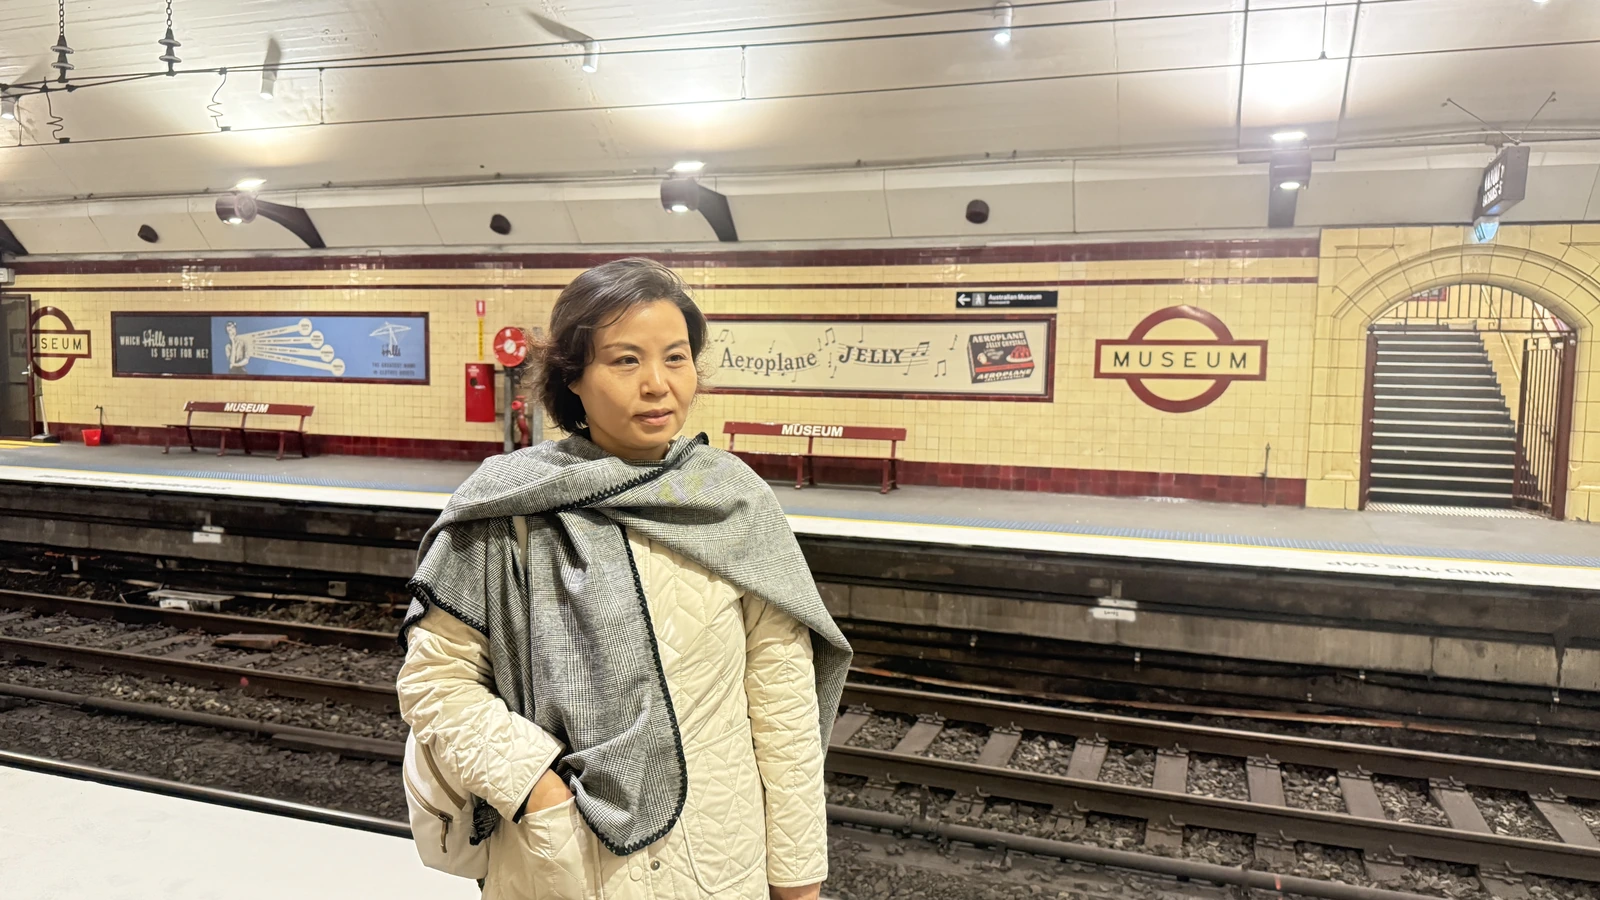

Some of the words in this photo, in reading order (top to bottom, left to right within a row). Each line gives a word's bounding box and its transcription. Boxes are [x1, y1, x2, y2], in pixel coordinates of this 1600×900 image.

[988, 293, 1017, 301] Australian
[1018, 293, 1043, 301] Museum
[119, 335, 141, 346] WHICH
[142, 328, 166, 348] Hills
[168, 336, 195, 347] HOIST
[972, 331, 1025, 344] AEROPLANE
[151, 348, 158, 358] IS
[161, 348, 177, 359] BEST
[180, 348, 193, 359] FOR
[195, 348, 209, 359] ME?
[1113, 351, 1247, 369] MUSEUM
[720, 347, 818, 376] Aeroplane
[838, 345, 905, 364] JELLY
[223, 402, 270, 414] MUSEUM
[781, 424, 844, 437] MUSEUM
[1444, 568, 1515, 578] MIND
